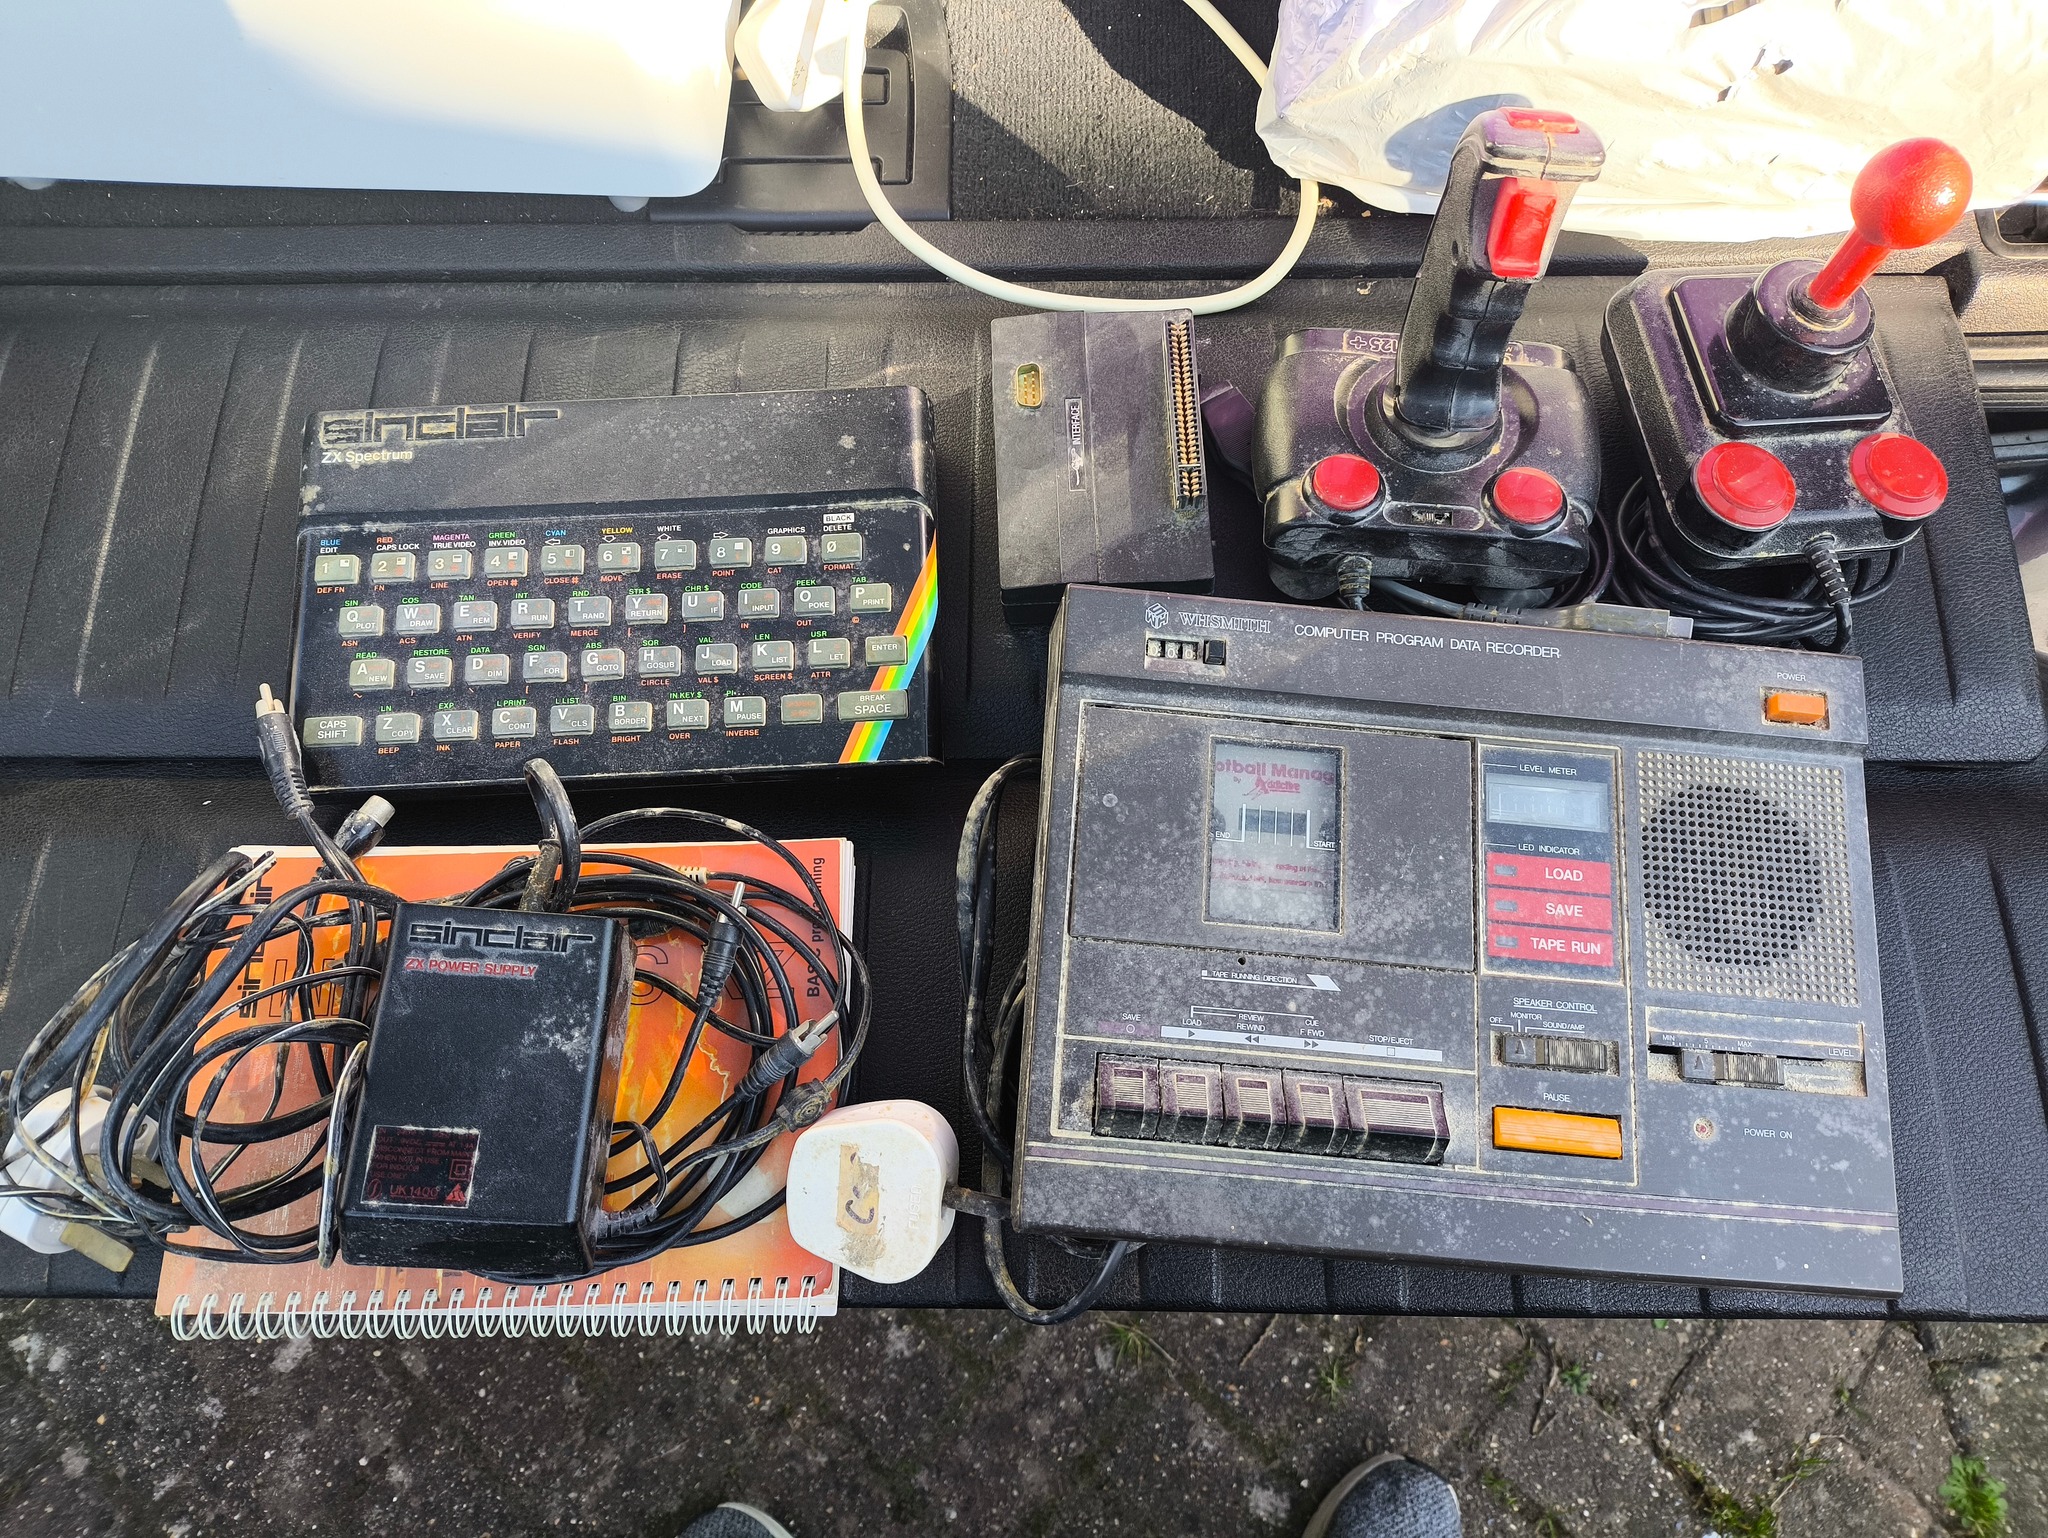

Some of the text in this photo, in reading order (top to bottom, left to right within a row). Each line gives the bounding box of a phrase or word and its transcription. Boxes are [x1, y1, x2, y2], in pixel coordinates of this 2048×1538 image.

[321, 405, 559, 447] sinclair
[321, 450, 412, 463] ZX Spectrum
[823, 524, 852, 532] DELETE
[1178, 611, 1560, 659] WHSMITH COMPUTER PROGRAM DATA RECORDER
[413, 648, 449, 656] RESTORE
[754, 673, 786, 681] SCREEN
[1777, 672, 1806, 681] POWER
[855, 704, 891, 714] SPACE
[320, 720, 347, 729] CAPS
[318, 730, 347, 738] SHIFT
[446, 726, 473, 734] CLEAR
[612, 735, 641, 743] BRIGHT
[1520, 764, 1577, 776] LEVEL METER
[1539, 845, 1580, 855] INDICATOR
[1546, 868, 1583, 881] LOAD
[1546, 903, 1583, 917] SAVE
[409, 920, 594, 952] sinclair
[1530, 937, 1600, 954] TAPE RUN
[405, 958, 537, 976] ZX POWER SUPPLY
[1232, 973, 1260, 981] RUNNING
[1263, 975, 1297, 984] DIRECTION
[1513, 997, 1597, 1012] SPEAKER CONTROL
[1122, 1013, 1141, 1021] SAVE
[1511, 1012, 1542, 1020] MONITOR
[1237, 1024, 1265, 1032] REWIND
[1305, 1019, 1319, 1027] CUE
[1369, 1035, 1413, 1045] STOP/EJECT
[1663, 1034, 1675, 1042] MIN
[1828, 1048, 1854, 1057] LEVEL
[1544, 1093, 1570, 1102] PAUSE
[1744, 1128, 1793, 1139] POWER ON
[390, 1184, 406, 1195] UK
